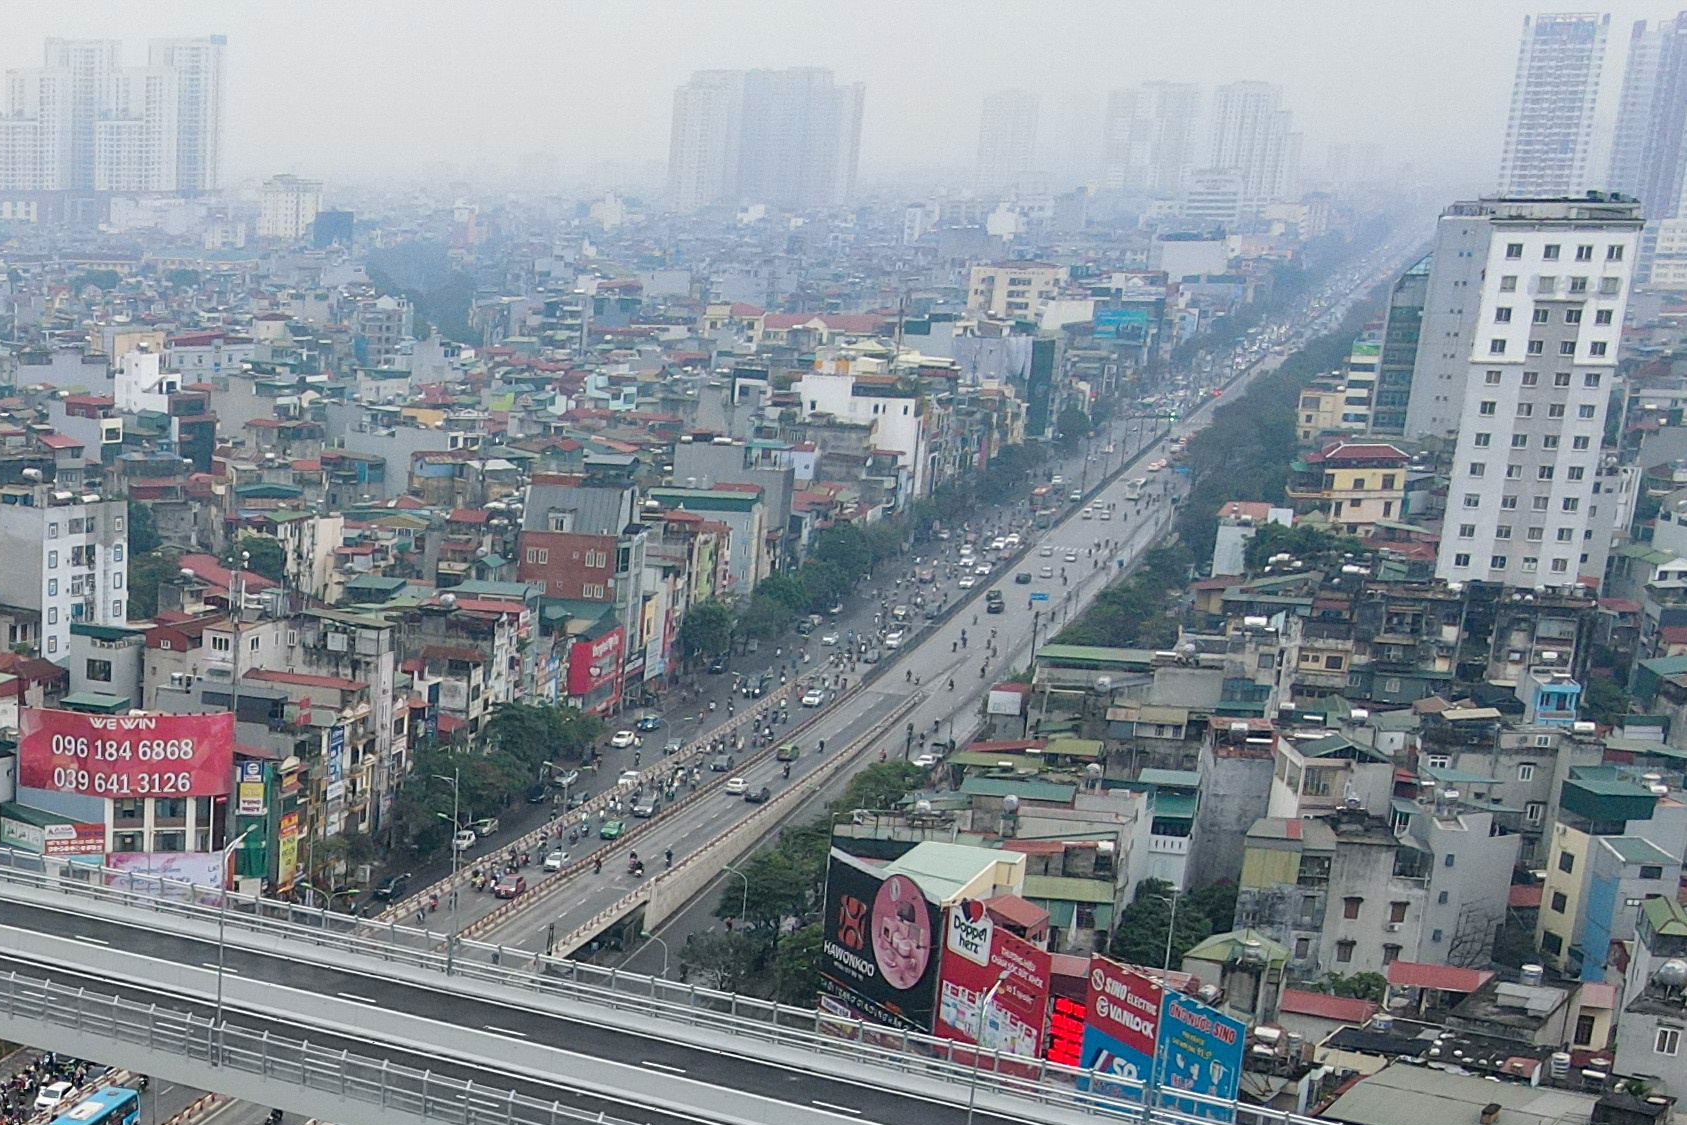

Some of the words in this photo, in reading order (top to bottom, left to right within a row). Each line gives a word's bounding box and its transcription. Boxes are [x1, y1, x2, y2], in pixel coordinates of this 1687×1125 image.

[90, 717, 117, 730] WE
[120, 718, 156, 730] WIN
[52, 734, 88, 758] 096
[94, 740, 132, 761] 184
[138, 739, 194, 761] 6868
[53, 767, 89, 790] 039
[94, 773, 131, 793] 641
[137, 772, 191, 793] 3126
[953, 915, 988, 942] Doppel
[958, 934, 980, 955] herz
[823, 940, 875, 977] HAWONKOO
[1104, 977, 1128, 1001] SINO
[1109, 1003, 1156, 1039] VANLOCK
[1213, 1021, 1237, 1045] SINO
